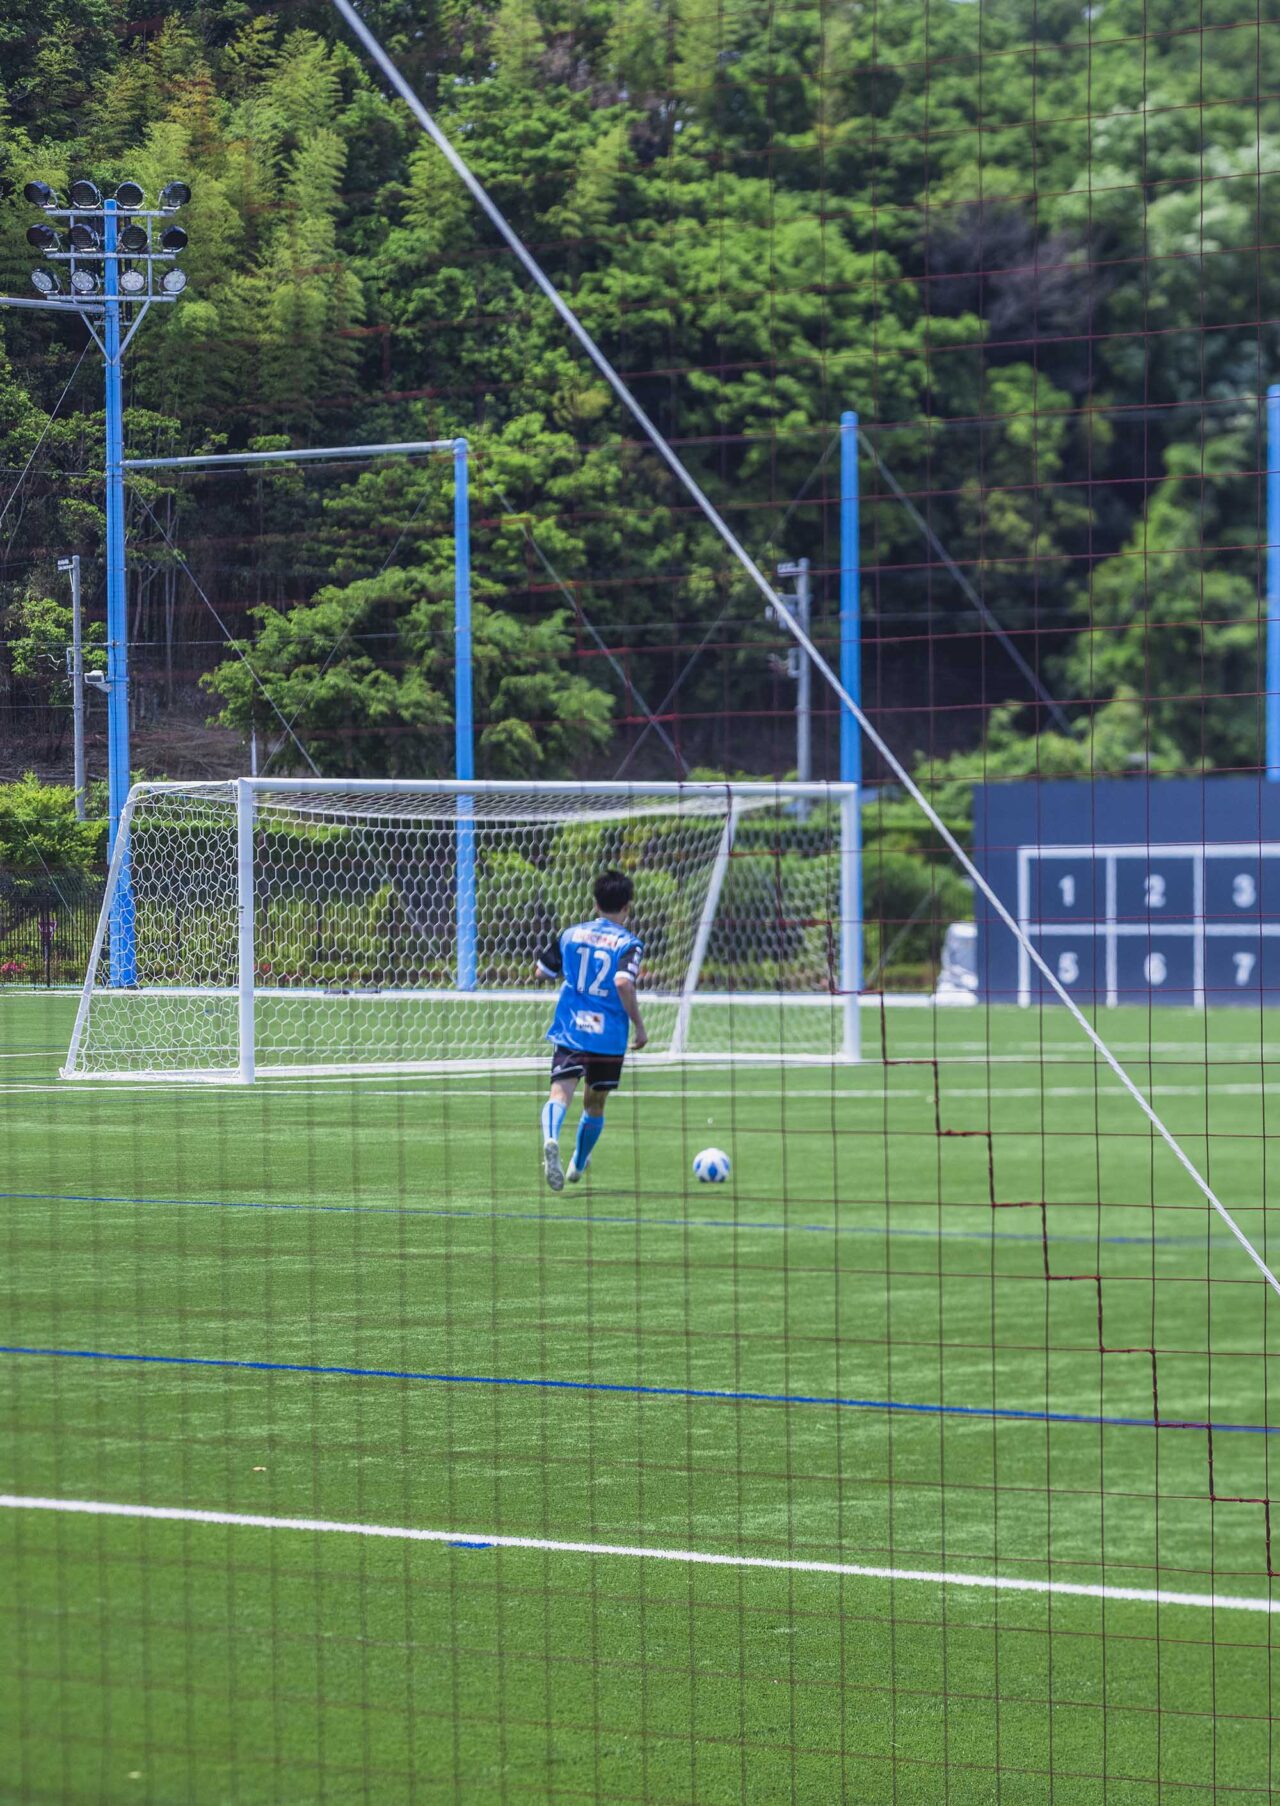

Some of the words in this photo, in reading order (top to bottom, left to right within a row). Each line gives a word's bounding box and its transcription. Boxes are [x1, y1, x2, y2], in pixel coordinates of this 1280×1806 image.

[1058, 874, 1075, 907] 1
[1144, 874, 1167, 908] 2
[1232, 873, 1256, 908] 3
[576, 947, 612, 997] 12
[1058, 951, 1079, 985] 5
[1143, 952, 1167, 985] 6
[1232, 952, 1256, 986] 7
